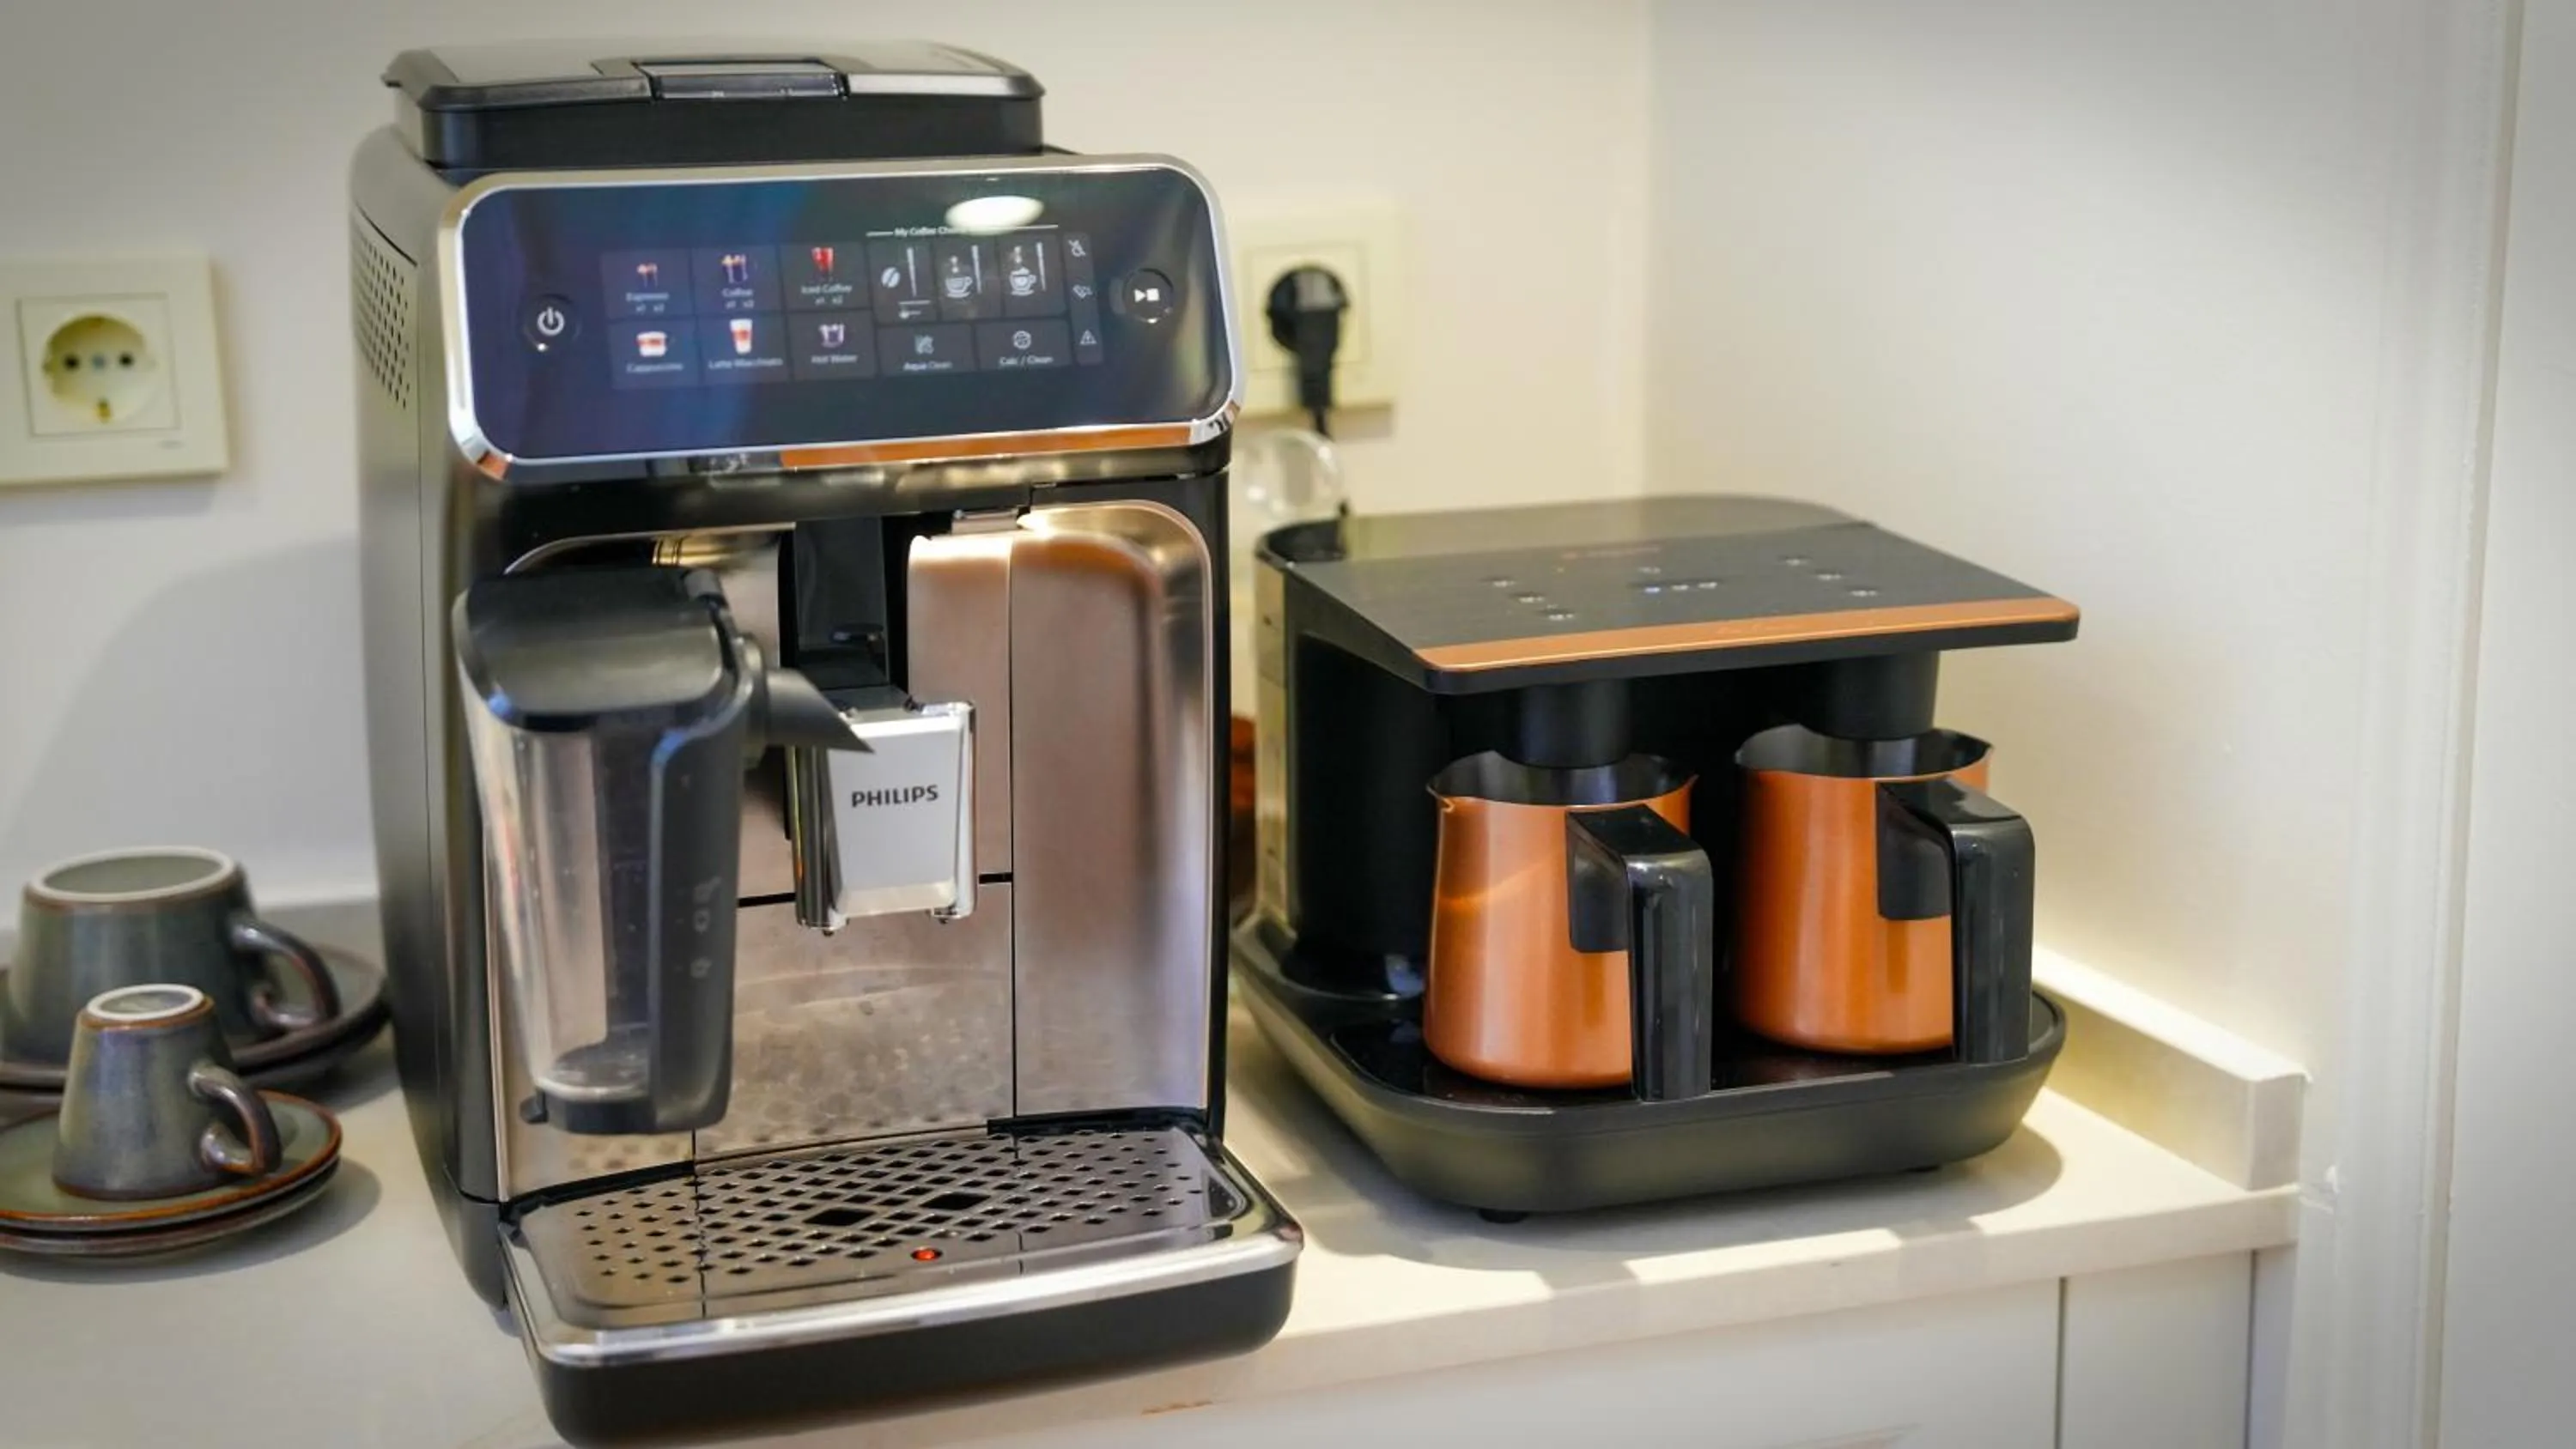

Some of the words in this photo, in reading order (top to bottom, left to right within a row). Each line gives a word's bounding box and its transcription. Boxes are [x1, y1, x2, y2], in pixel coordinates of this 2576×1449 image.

[909, 226, 936, 236] Coffee
[822, 283, 853, 294] Coffee
[1027, 355, 1054, 365] Clean
[851, 784, 939, 808] PHILIPS
